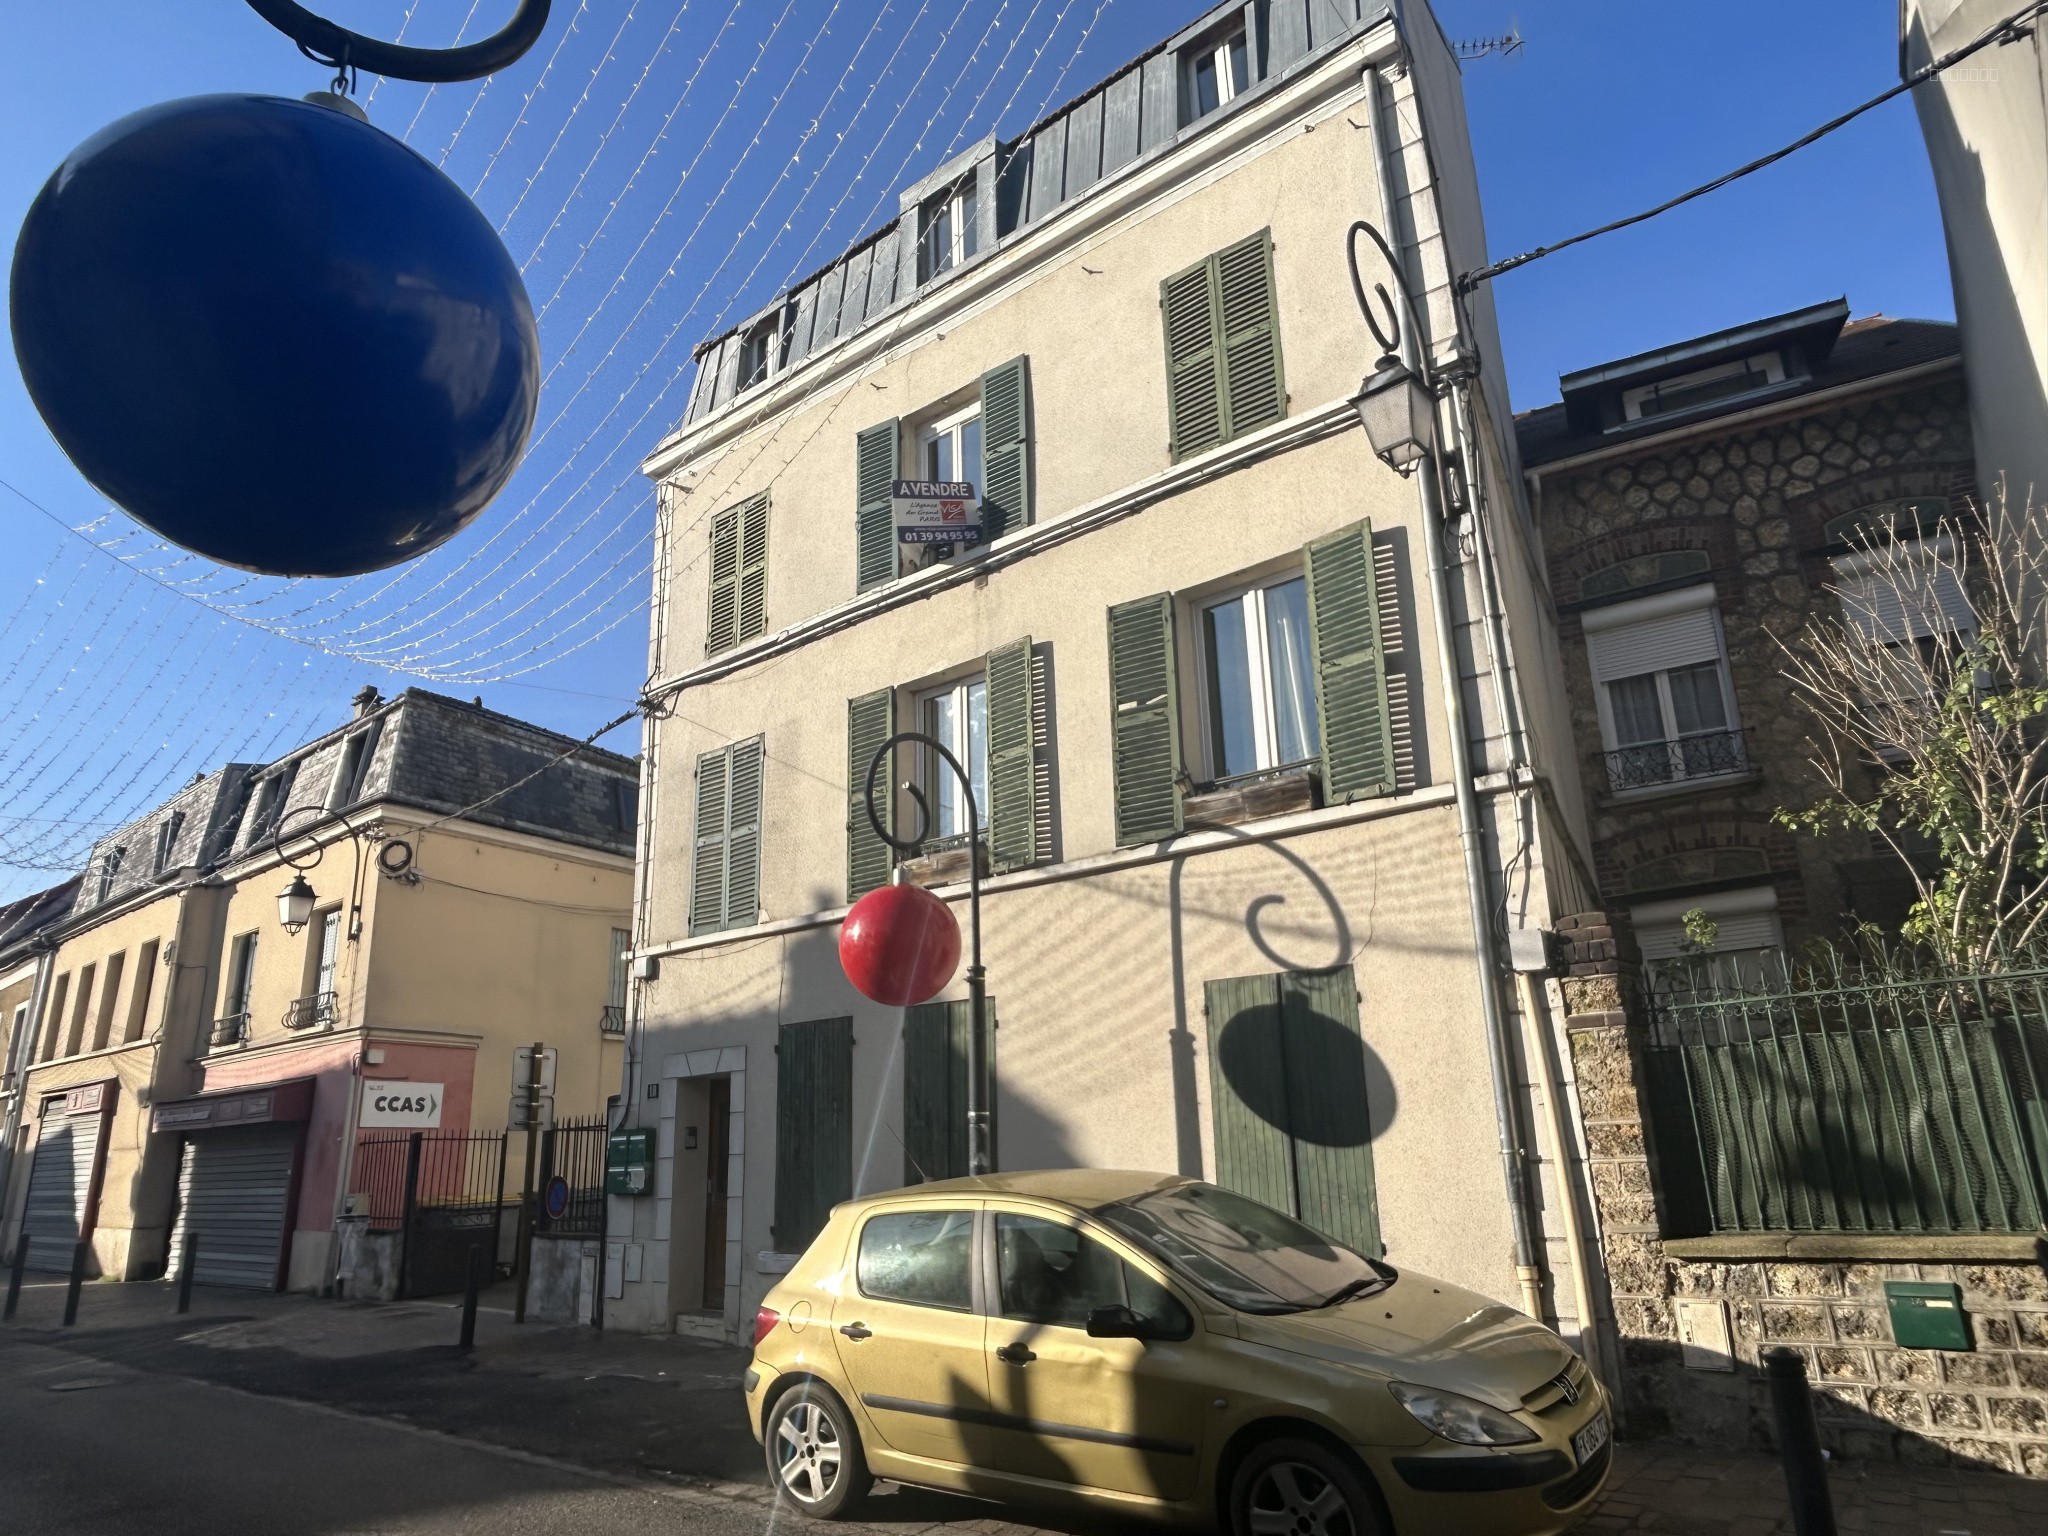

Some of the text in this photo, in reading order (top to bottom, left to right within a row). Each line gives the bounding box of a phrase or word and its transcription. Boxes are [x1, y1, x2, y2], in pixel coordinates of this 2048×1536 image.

[900, 482, 969, 496] A VENDRE
[905, 530, 978, 541] 01 39 94 95 95
[374, 1095, 426, 1113] CCAS
